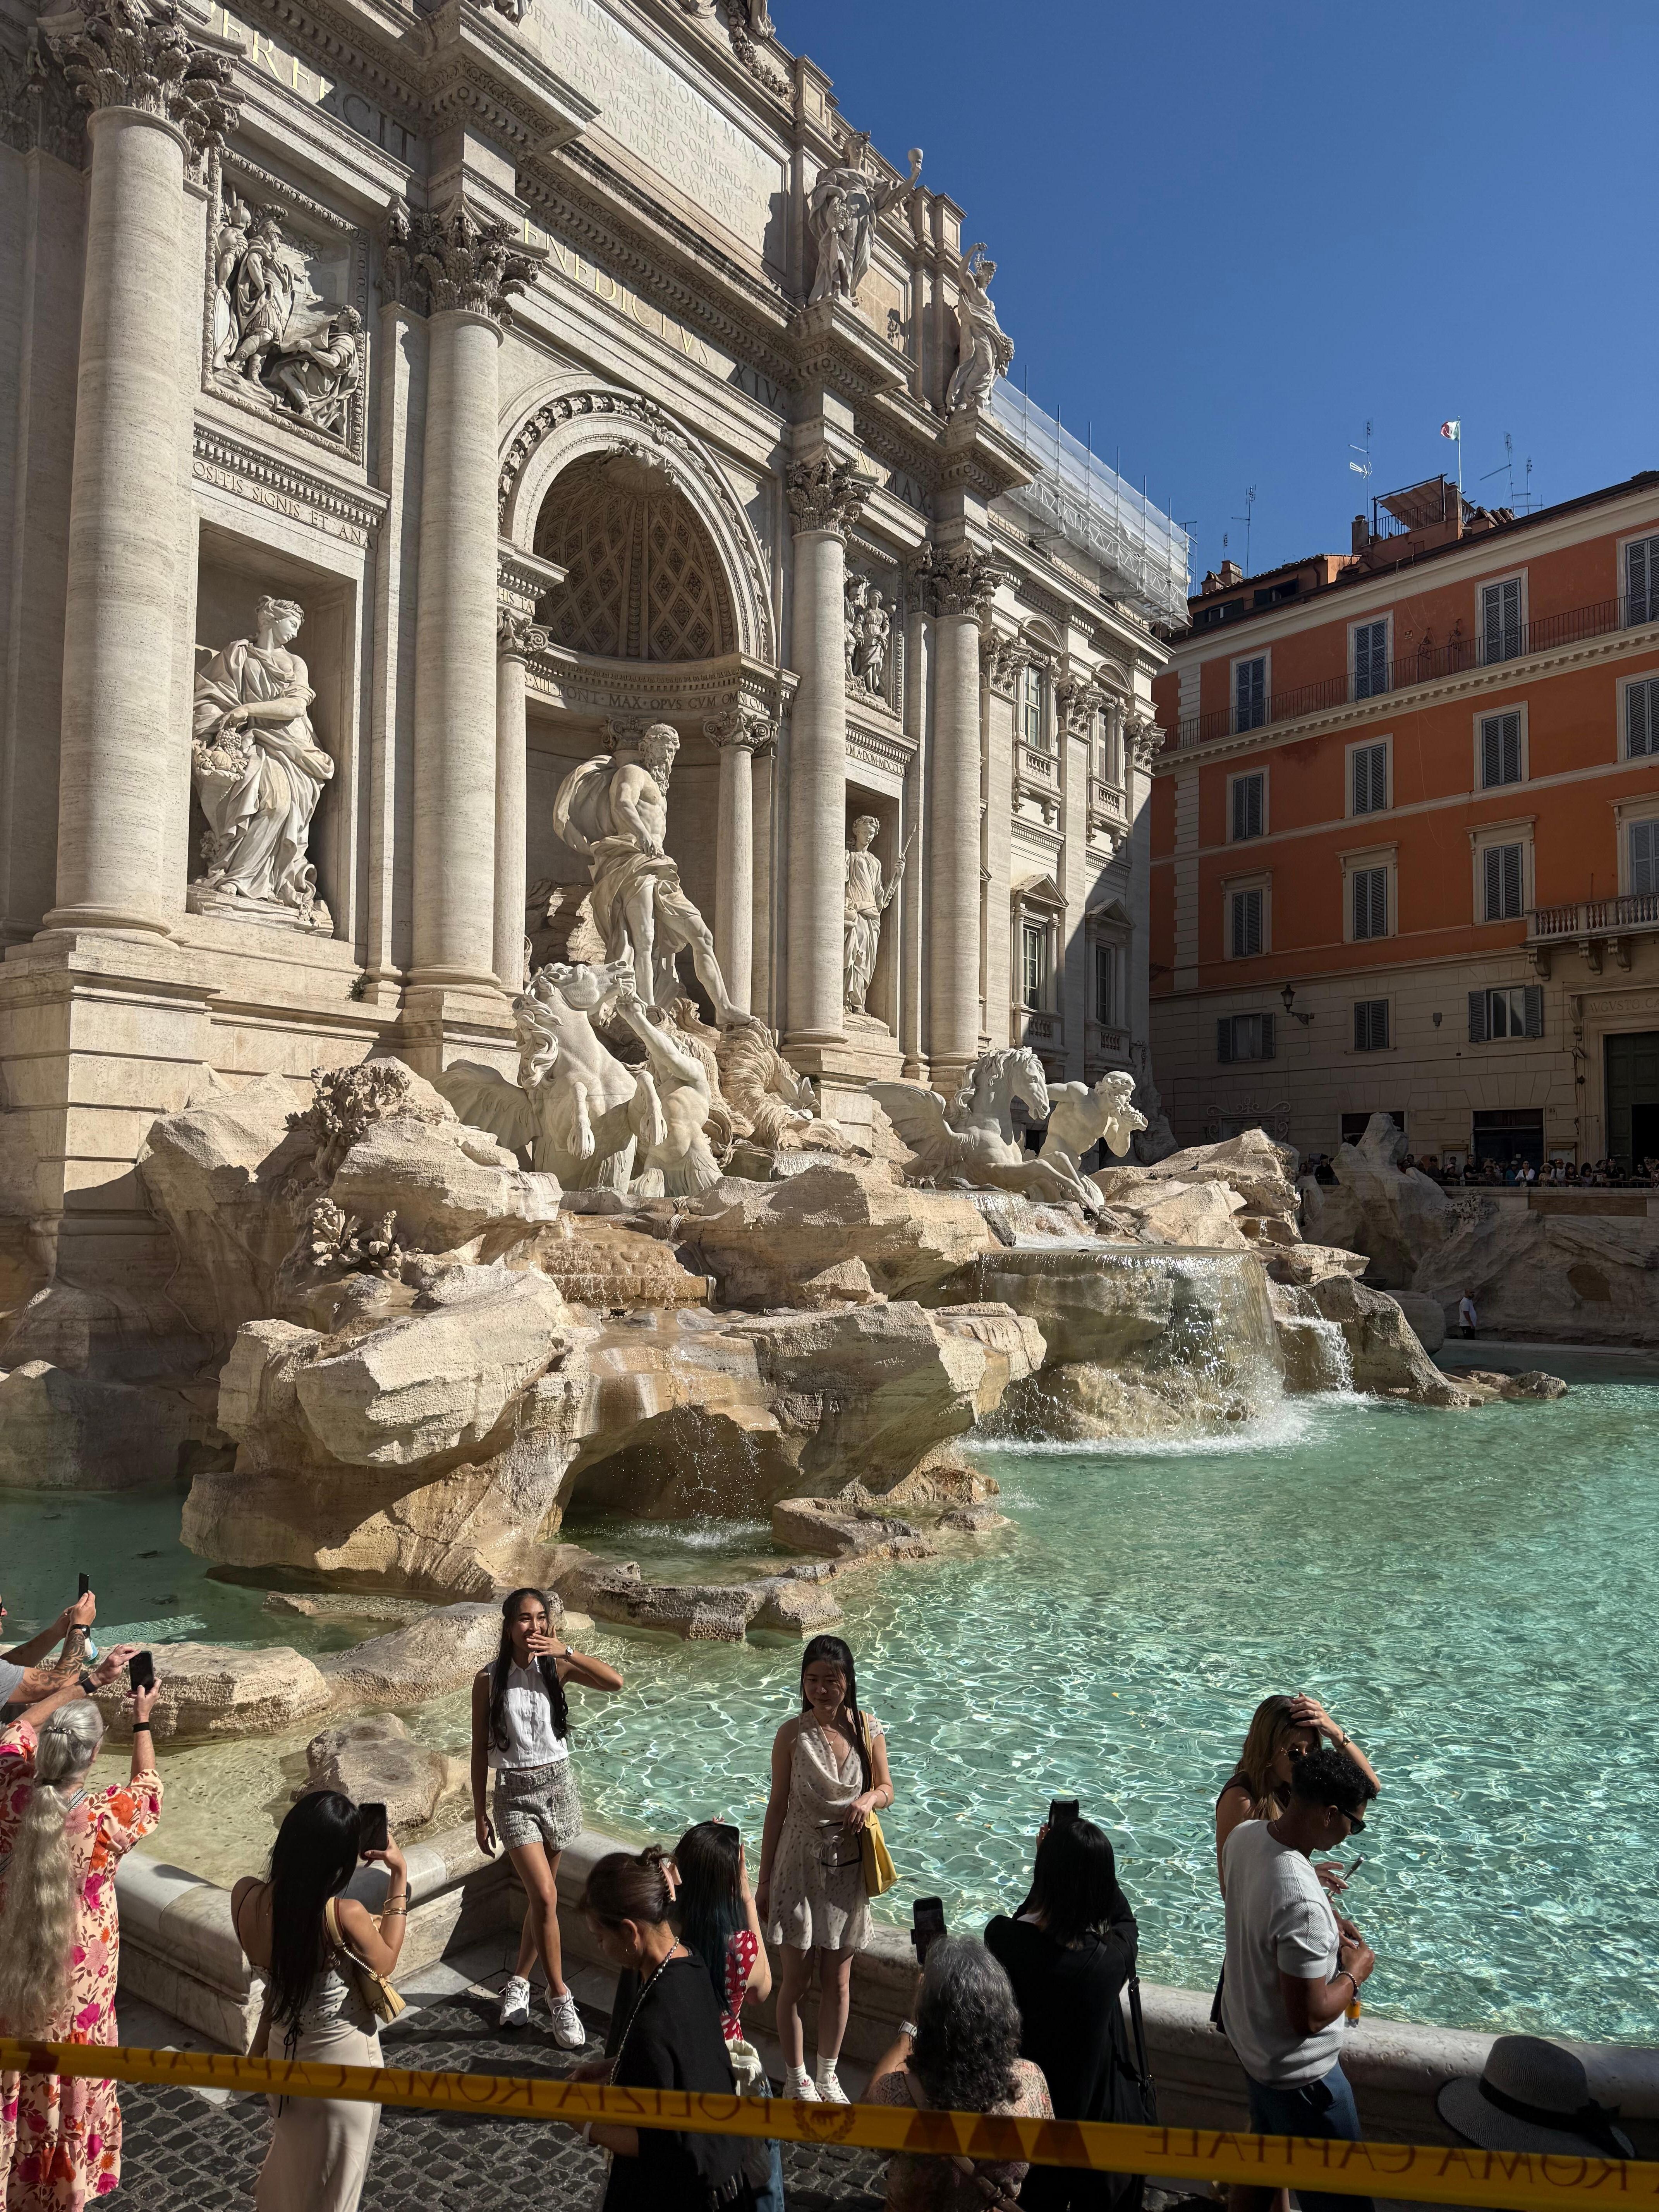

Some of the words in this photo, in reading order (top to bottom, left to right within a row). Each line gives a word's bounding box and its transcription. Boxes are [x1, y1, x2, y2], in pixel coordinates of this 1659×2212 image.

[565, 31, 581, 55] ET
[211, 0, 417, 162] ERFECIT
[651, 82, 715, 149] VIRGINEM
[193, 462, 243, 493] OSITIS
[253, 486, 300, 518] SIGNIS
[311, 510, 328, 529] ET
[338, 524, 373, 550] ANA
[519, 597, 533, 614] TA
[651, 699, 682, 709] OPVS
[689, 696, 716, 708] CVM
